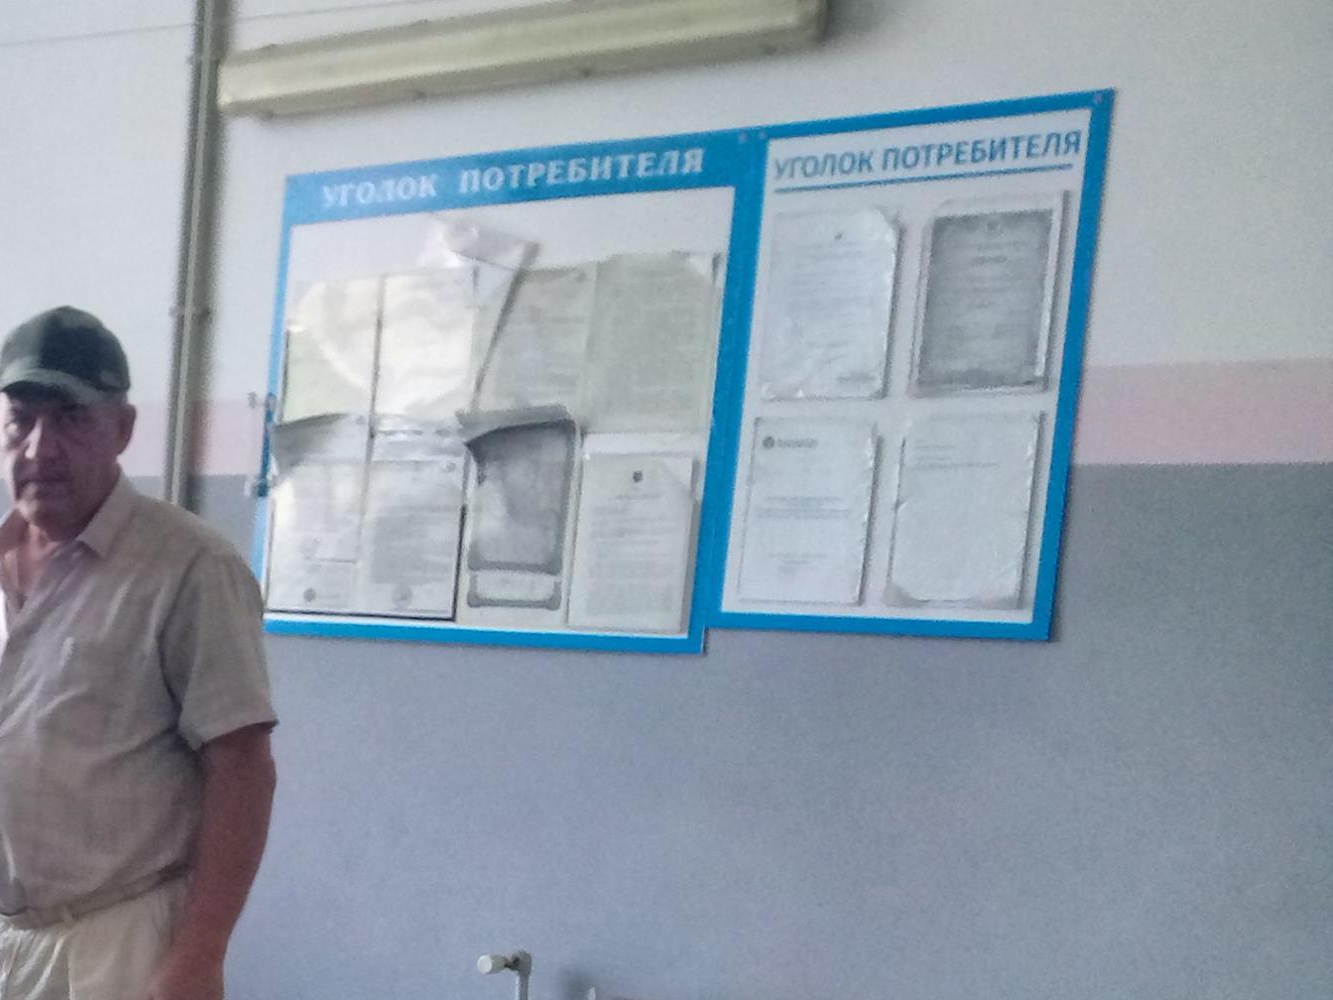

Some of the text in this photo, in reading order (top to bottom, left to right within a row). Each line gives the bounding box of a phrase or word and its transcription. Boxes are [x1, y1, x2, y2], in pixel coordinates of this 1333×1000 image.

[322, 148, 706, 207] УГОЛОК ПОТРЕБИТЕЛЯ
[774, 130, 1082, 179] УГОЛОК ПОТРЕБИТЕЛЯ
